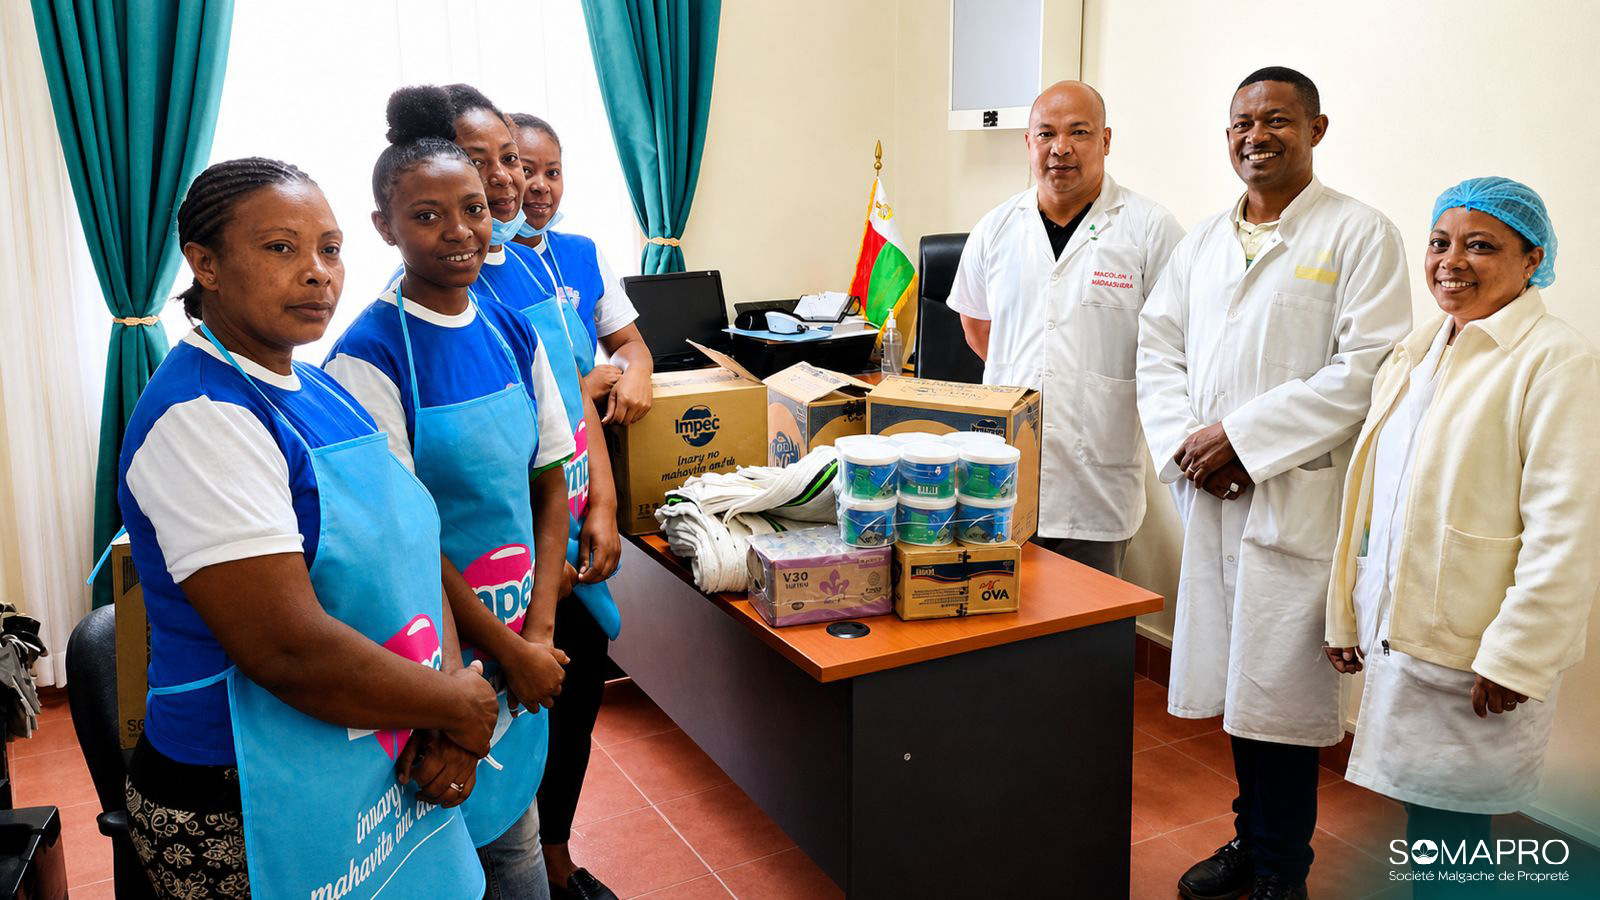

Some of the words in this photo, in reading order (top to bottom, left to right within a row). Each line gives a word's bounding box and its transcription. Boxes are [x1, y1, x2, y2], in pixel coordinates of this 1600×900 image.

[675, 417, 720, 437] Impec
[707, 450, 720, 460] no
[782, 571, 809, 583] V30
[981, 588, 1010, 601] OVA
